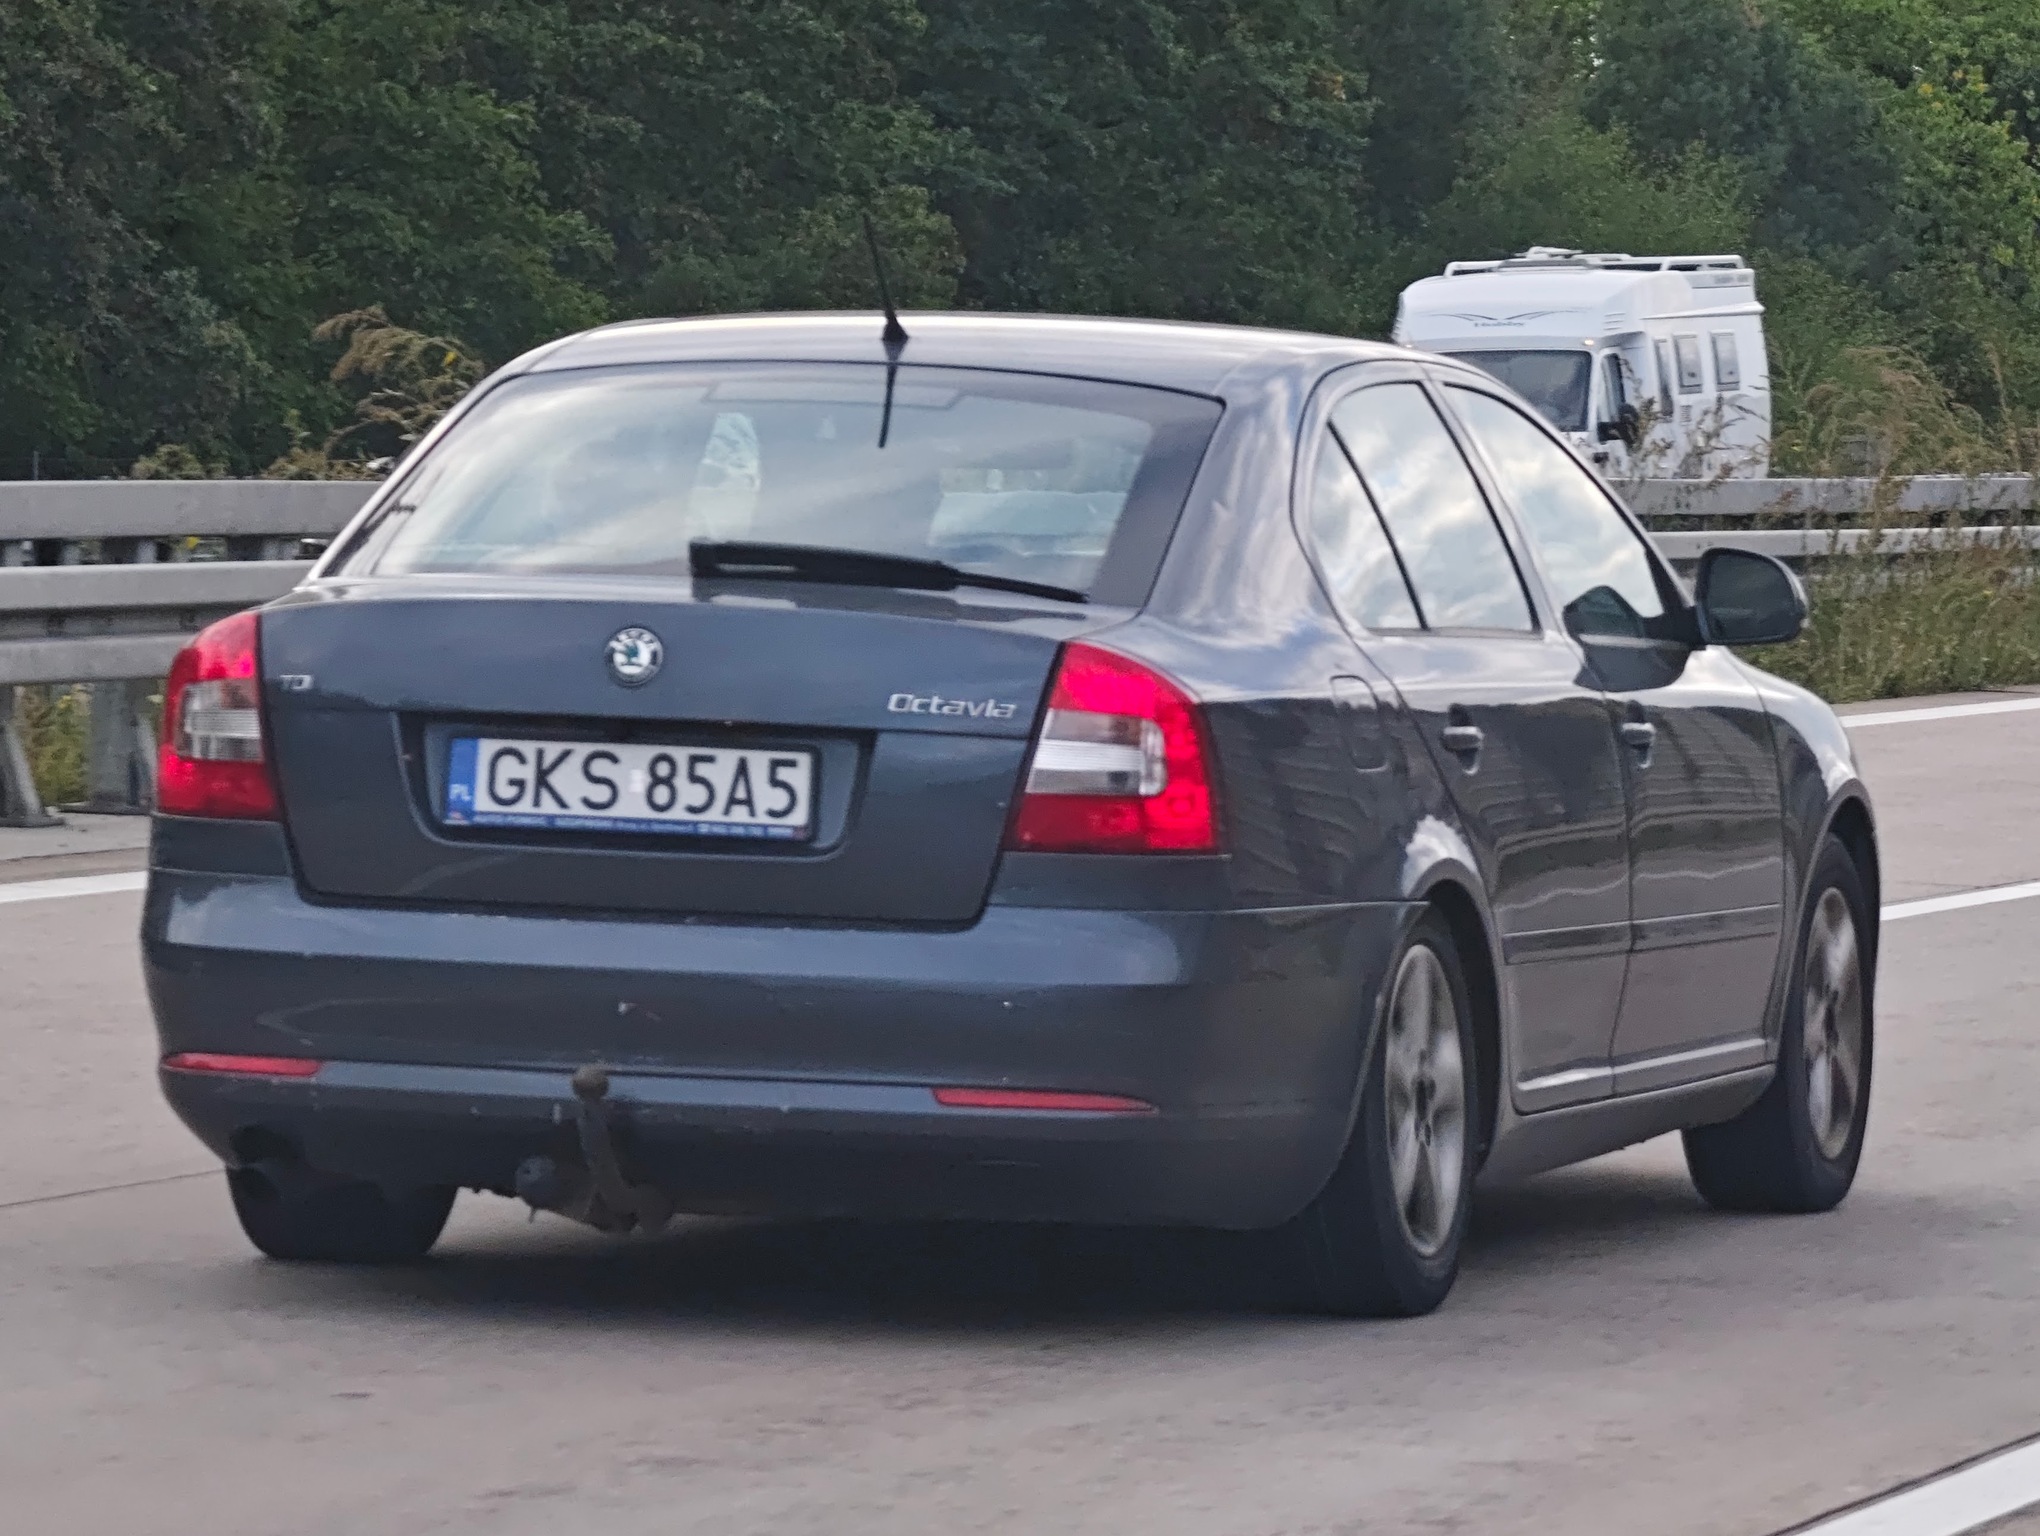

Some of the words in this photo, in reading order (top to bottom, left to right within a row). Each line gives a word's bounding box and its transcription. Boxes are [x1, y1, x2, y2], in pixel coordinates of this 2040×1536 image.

[886, 692, 1017, 719] Octavia
[488, 745, 621, 812] GKS
[645, 752, 798, 819] 85A5
